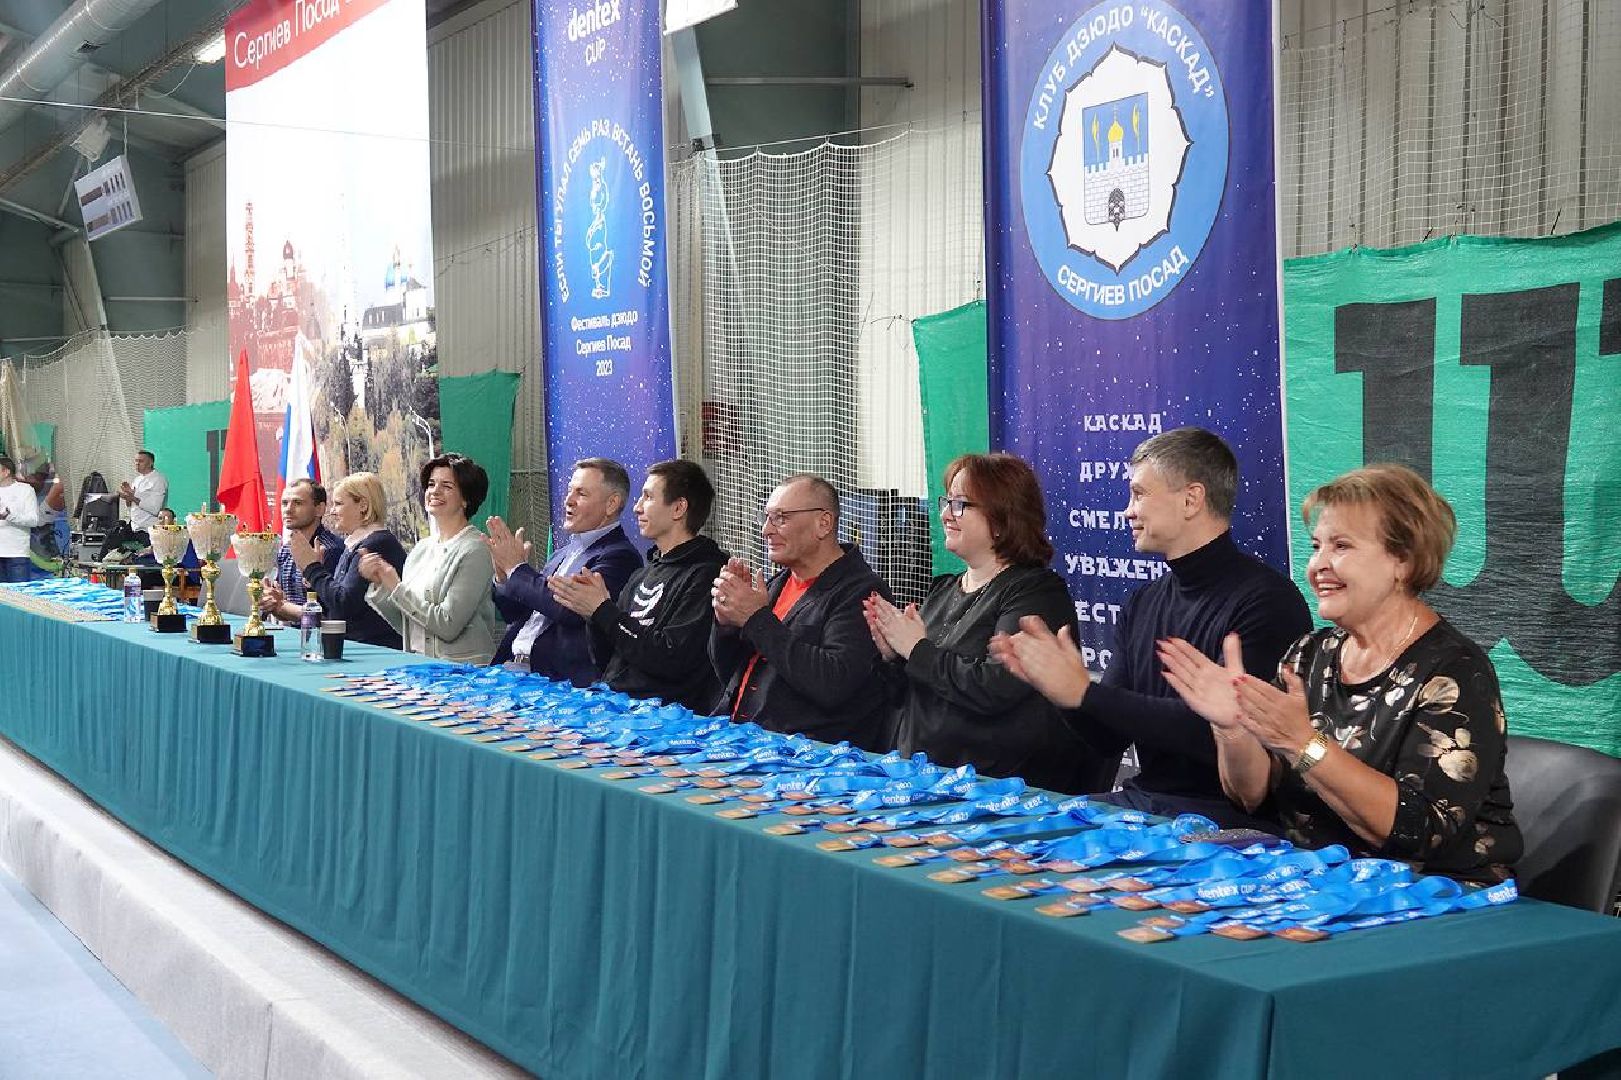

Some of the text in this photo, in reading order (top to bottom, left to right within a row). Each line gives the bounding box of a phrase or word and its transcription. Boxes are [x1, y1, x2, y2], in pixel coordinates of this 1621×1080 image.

[234, 0, 340, 69] Сергиев Посад
[568, 0, 621, 41] dentex
[585, 38, 606, 66] CUP
[1033, 60, 1067, 130] КЛУБ
[1066, 5, 1134, 67] ДЗЮДО
[568, 128, 592, 163] СЕМЬ
[611, 124, 644, 182] ВСТАНЬ
[555, 162, 572, 215] УПАЛ
[554, 219, 564, 249] ТЫ
[639, 182, 656, 288] ВОСЬМОЙ
[1057, 245, 1190, 305] СЕРГИЕВ ПОСАД
[576, 334, 632, 358] Сергиев Посад
[1083, 413, 1163, 434] КАСКАД
[1079, 461, 1134, 483] ДРУЖ
[1069, 508, 1132, 530] СМЕЛ
[1064, 553, 1172, 580] УВАЖЕН
[1074, 600, 1121, 625] ЕСТ
[1198, 884, 1239, 899] dentex
